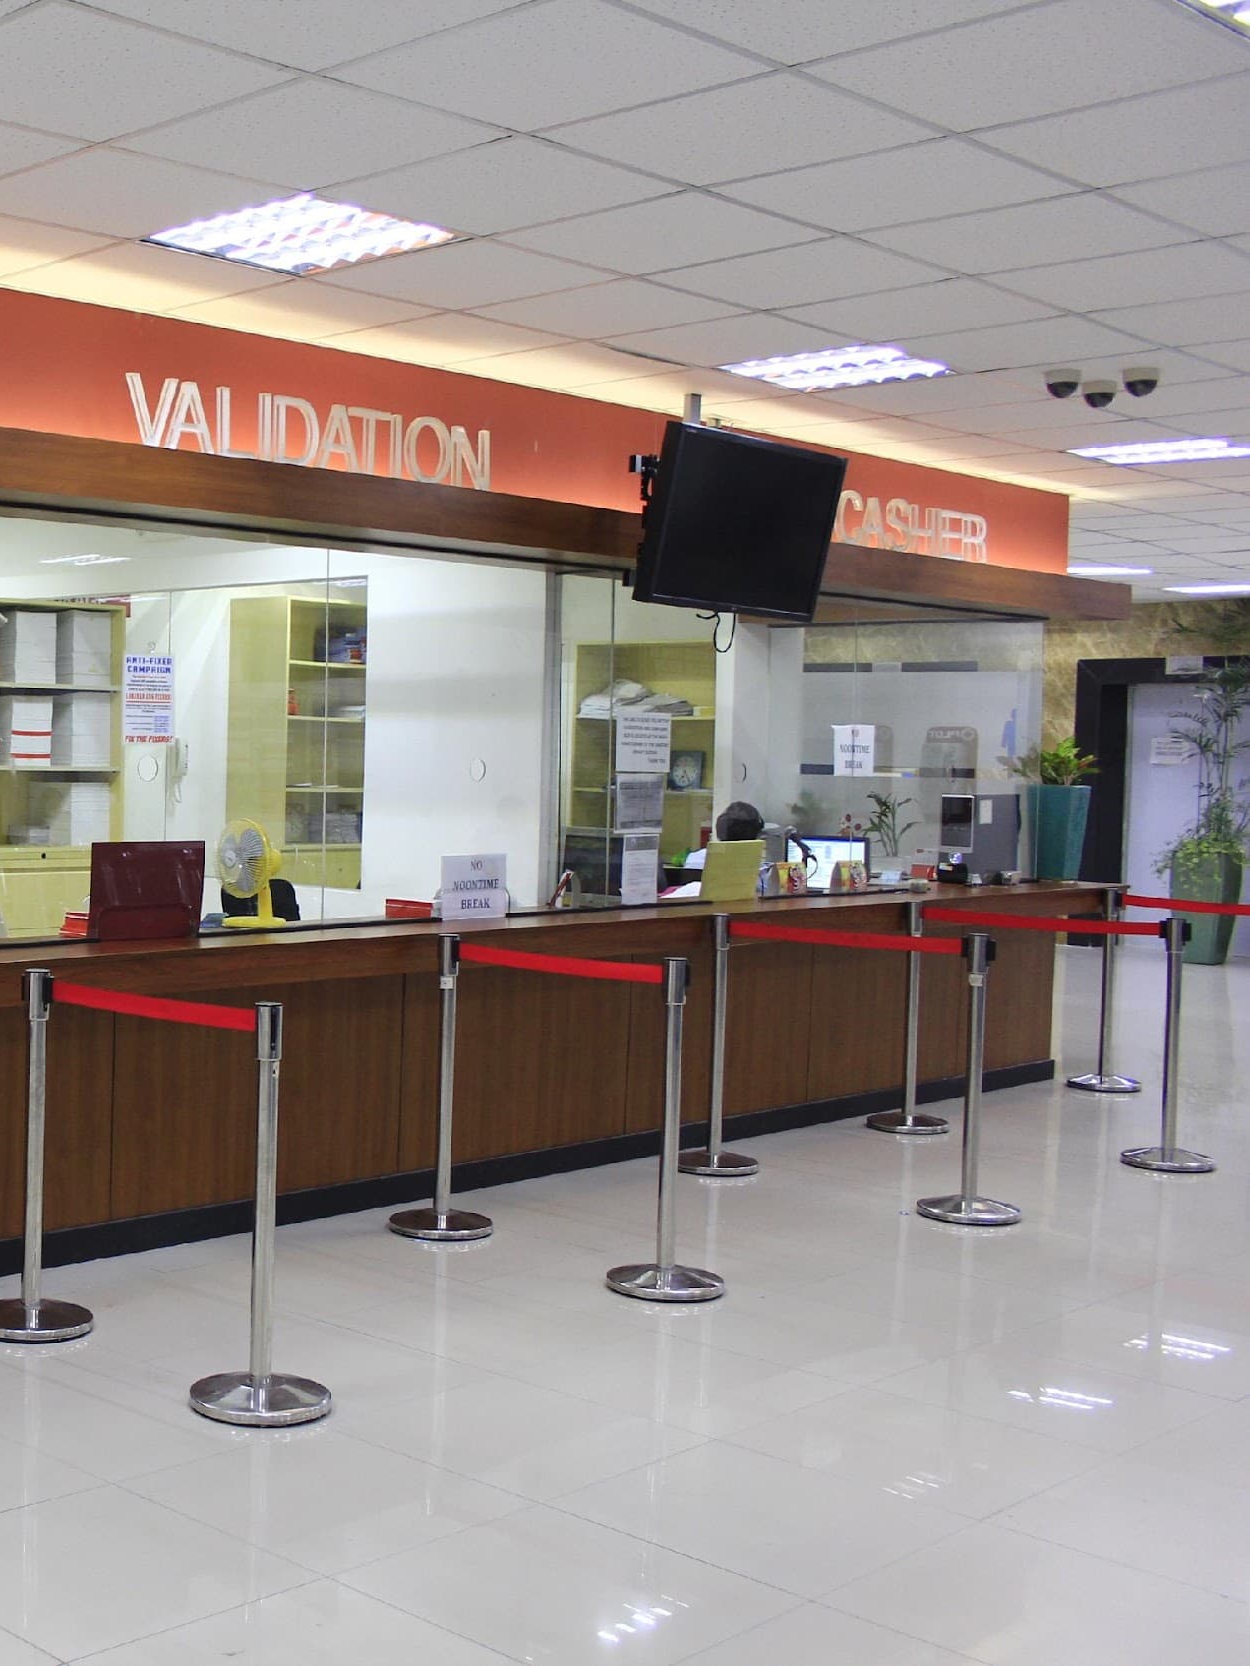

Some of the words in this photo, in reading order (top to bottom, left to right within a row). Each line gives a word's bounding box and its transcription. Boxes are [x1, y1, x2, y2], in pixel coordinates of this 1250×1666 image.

[125, 372, 490, 490] VALIDATION
[126, 656, 173, 665] ANTI-FIXER
[127, 665, 171, 674] CAMPAIGN
[840, 744, 870, 753] NOONTIME
[470, 860, 483, 871] NO
[453, 879, 499, 891] NOONTIME
[461, 898, 490, 909] BREAK
